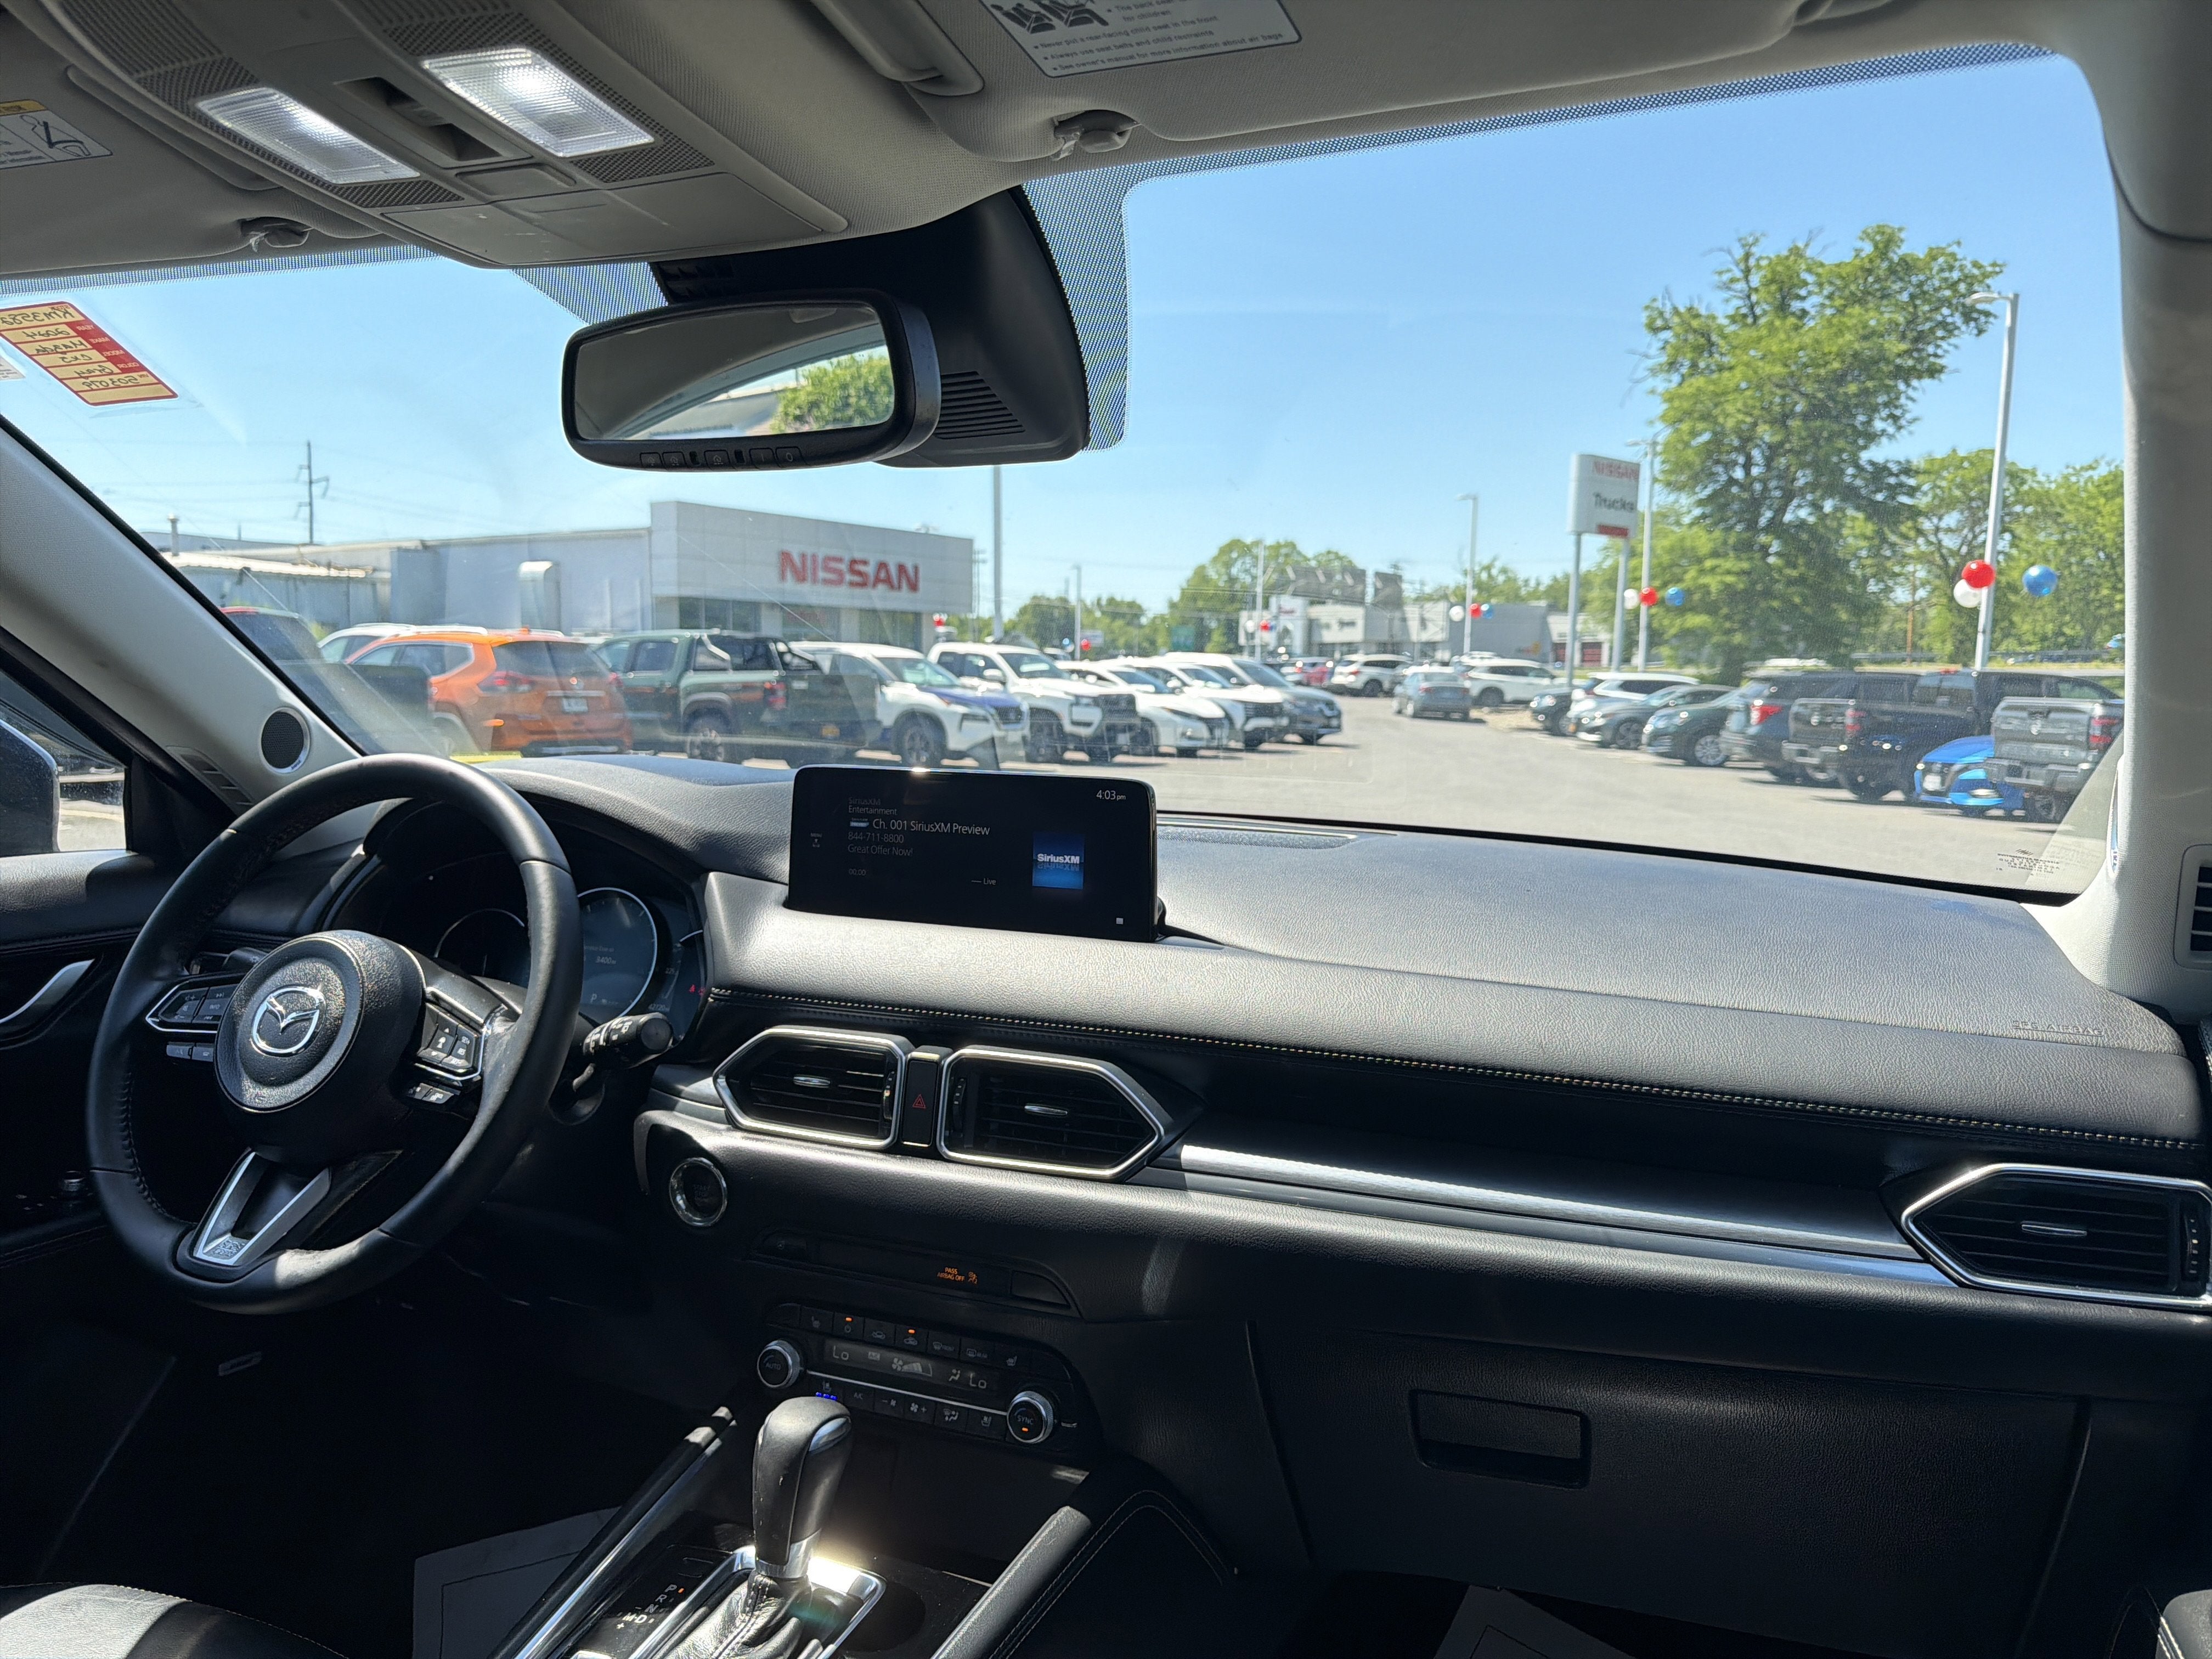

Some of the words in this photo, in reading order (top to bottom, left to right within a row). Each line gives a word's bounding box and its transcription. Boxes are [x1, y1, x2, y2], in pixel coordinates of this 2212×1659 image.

[1137, 9, 1172, 20] children
[1085, 30, 1130, 42] rear-facing
[1130, 26, 1151, 35] child
[1196, 15, 1218, 24] front
[1051, 51, 1079, 60] Always
[1095, 45, 1114, 53] seat
[1113, 42, 1134, 50] belts
[1135, 39, 1150, 47] and
[1152, 36, 1173, 44] child
[1173, 30, 1215, 41] restraints
[1107, 55, 1136, 63] manual
[1172, 42, 1221, 54] information
[1221, 38, 1247, 47] about
[1260, 32, 1284, 42] bags
[1593, 461, 1639, 480] NISSAN
[1593, 493, 1635, 512] Trucks
[778, 549, 920, 594] NISSAN
[848, 805, 898, 816] Entertainment
[872, 819, 888, 830] Ch.
[889, 820, 907, 831] 001
[910, 820, 951, 833] SiriusXM
[952, 823, 991, 836] Preview
[848, 831, 904, 844] 844-711-8800
[848, 844, 870, 854] Great
[870, 845, 891, 855] Offer
[892, 847, 913, 857] Now!
[1037, 853, 1080, 864] SiriusXM
[2046, 1024, 2103, 1036] AIRBAG
[1017, 1415, 1034, 1425] SYNC
[664, 1584, 678, 1592] P
[654, 1594, 668, 1603] R
[644, 1604, 659, 1613] N
